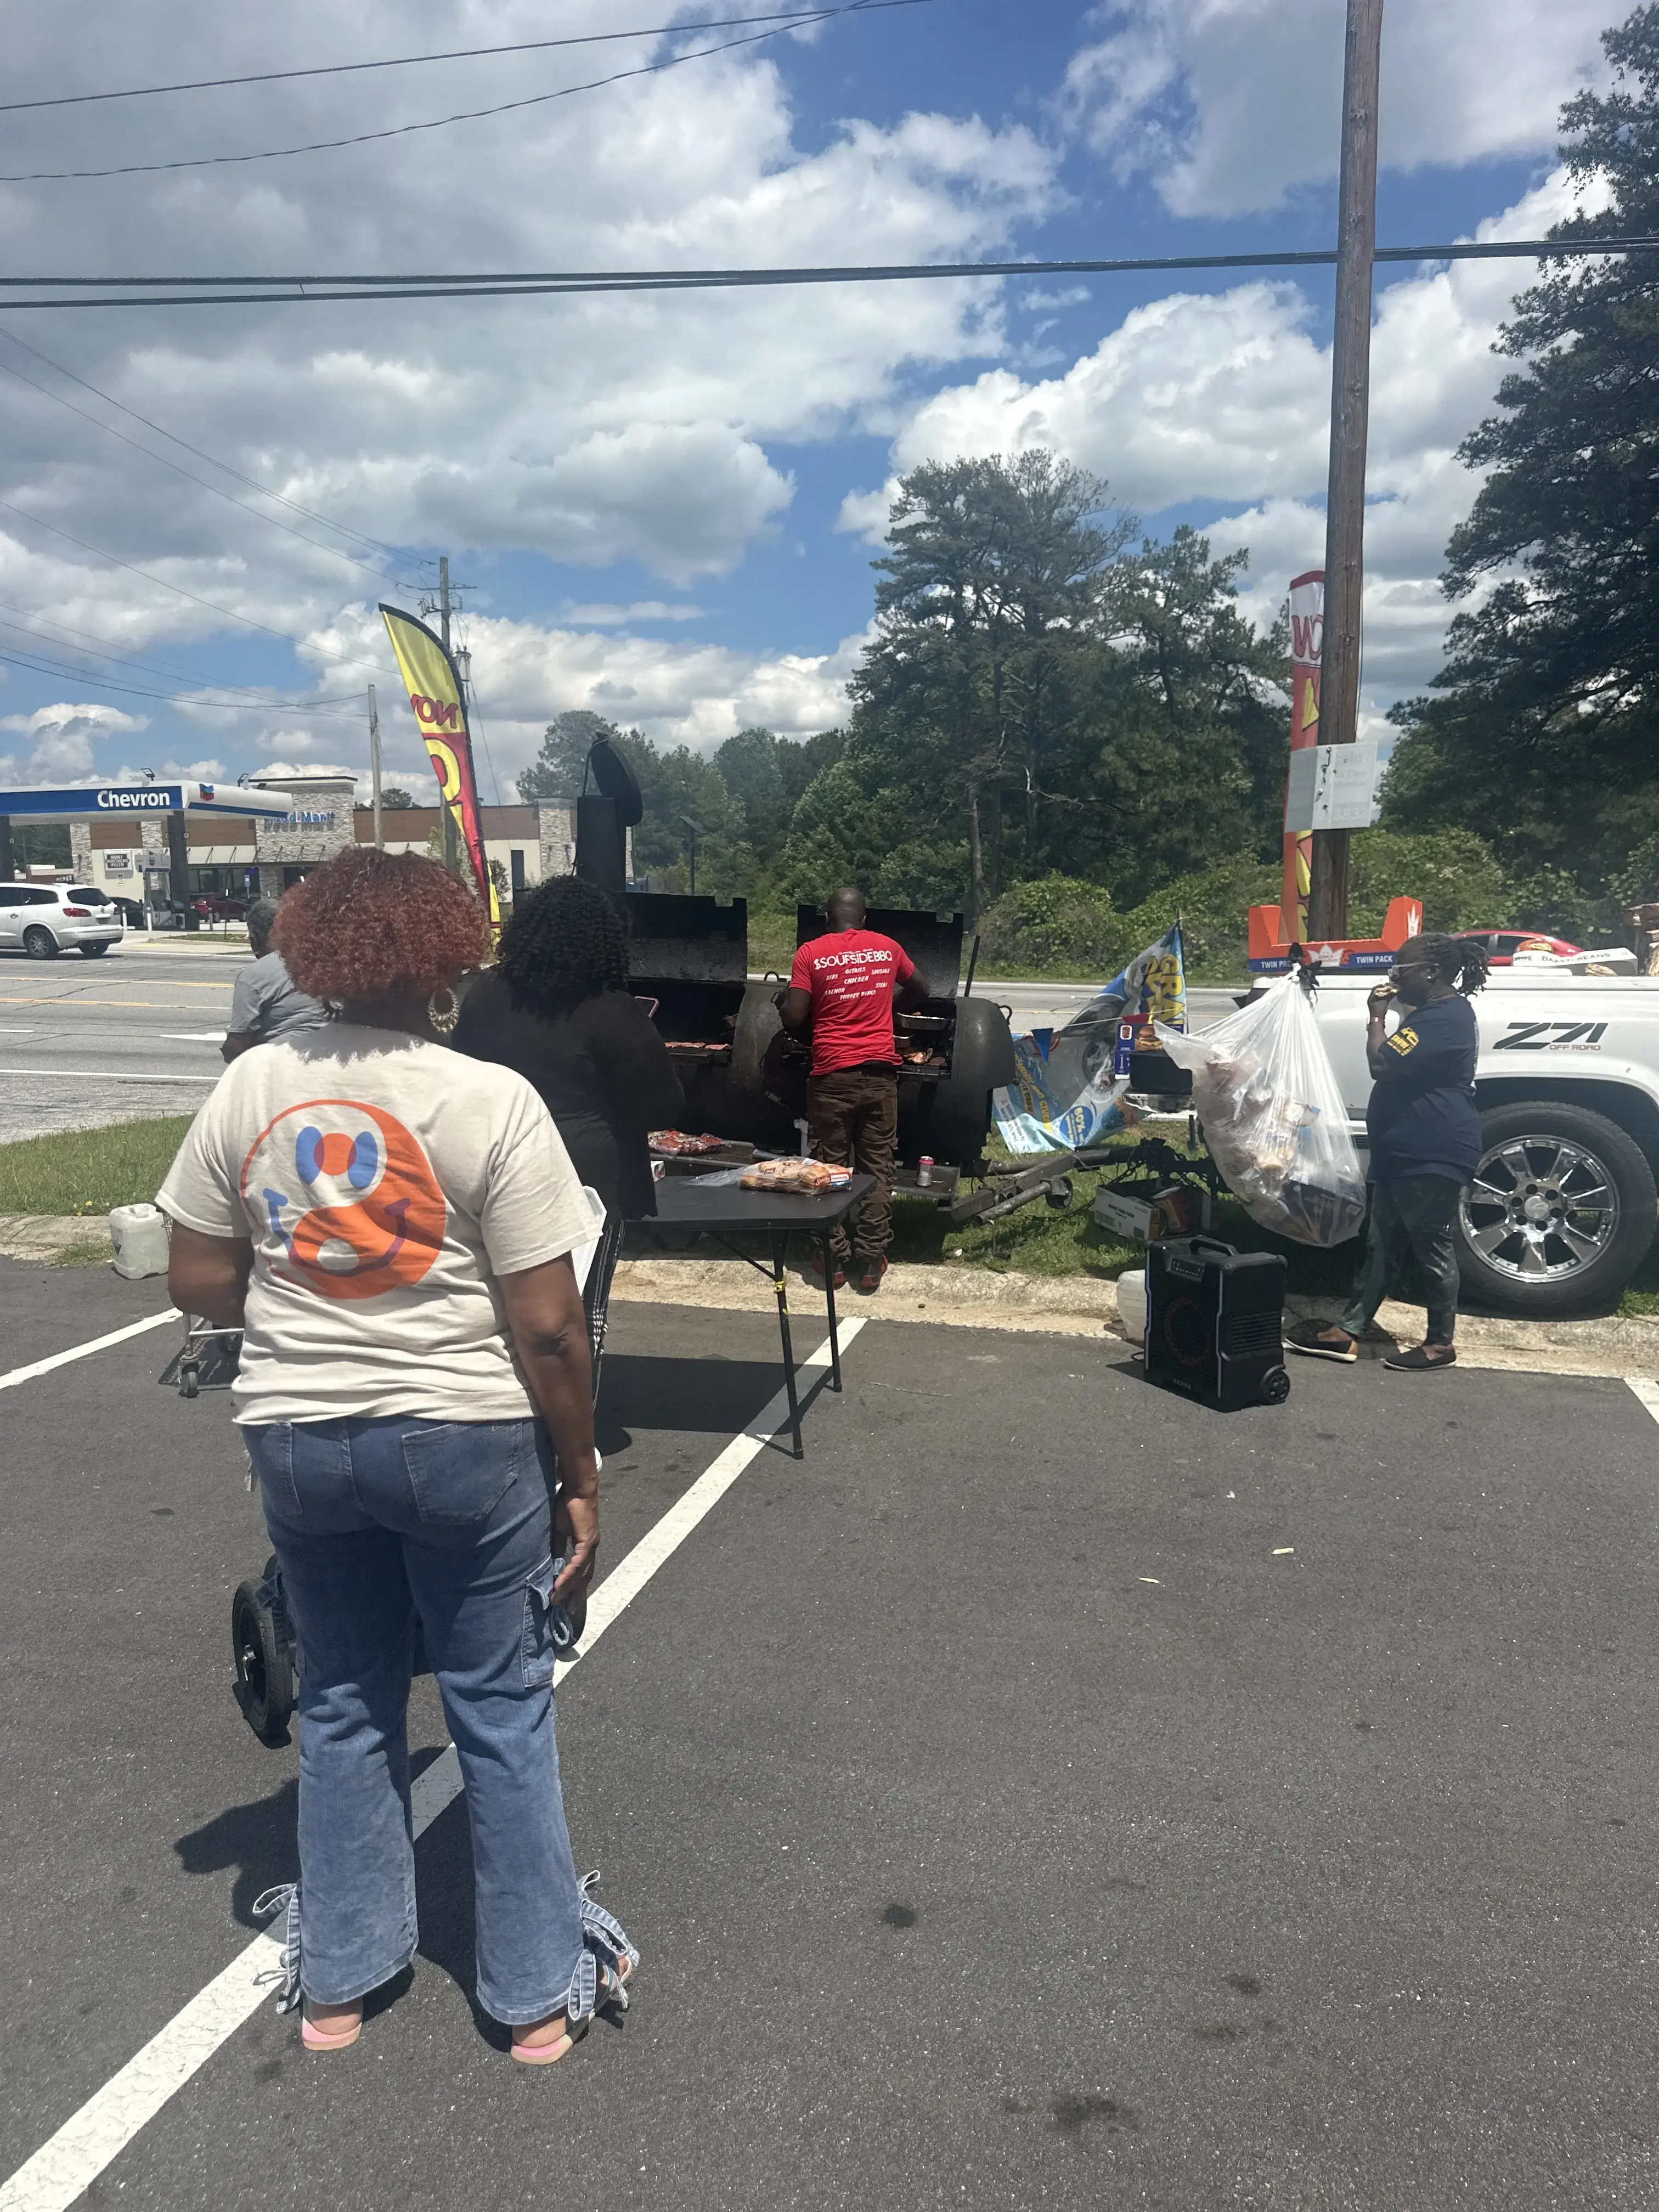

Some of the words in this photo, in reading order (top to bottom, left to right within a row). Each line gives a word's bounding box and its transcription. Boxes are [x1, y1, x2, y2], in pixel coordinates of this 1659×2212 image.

[98, 790, 170, 808] Chevron
[301, 811, 335, 823] Mart
[844, 975, 870, 984] CHICKEN
[824, 988, 846, 996] SALMON
[1493, 1023, 1609, 1049] Z71
